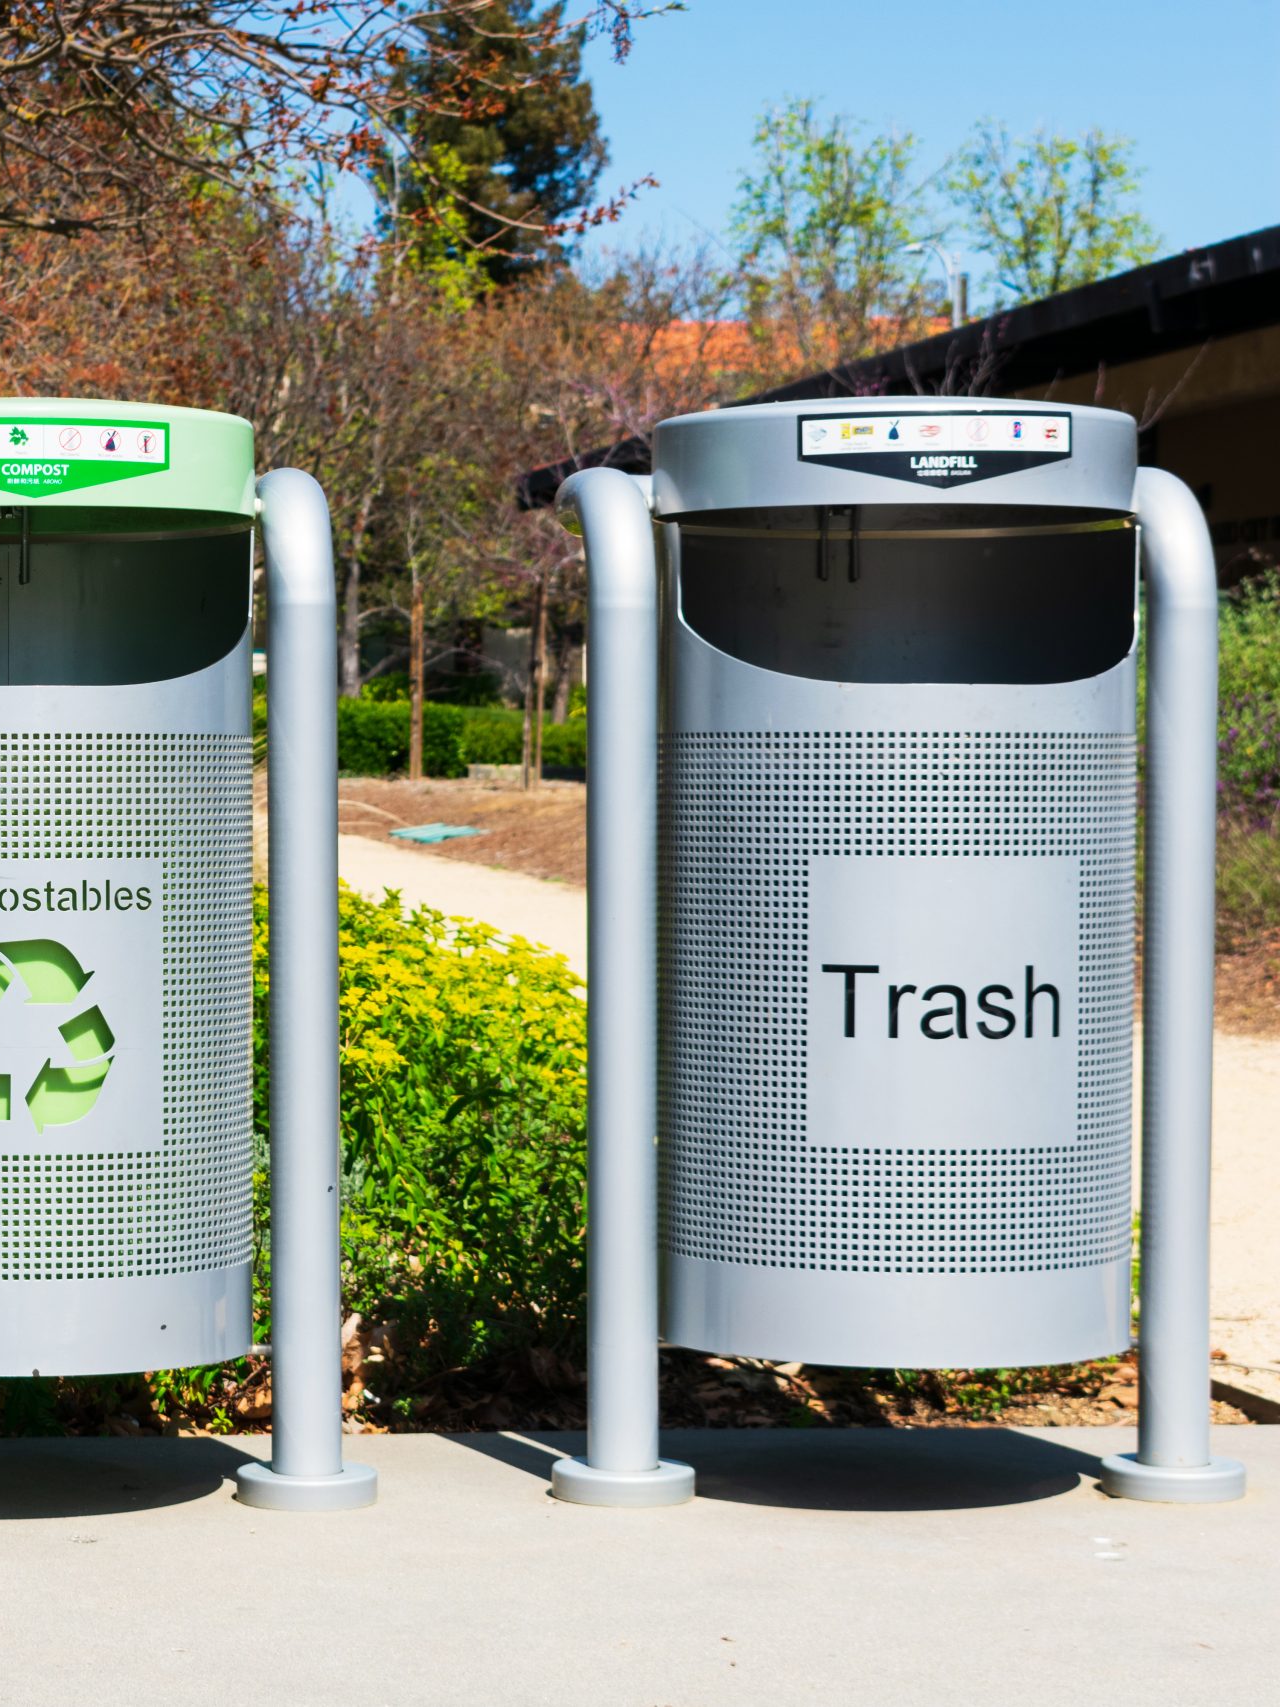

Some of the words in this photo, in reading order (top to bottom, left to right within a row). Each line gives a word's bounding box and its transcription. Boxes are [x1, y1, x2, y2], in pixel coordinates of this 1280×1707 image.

[910, 455, 979, 469] LANDFILL
[1, 463, 70, 476] COMPOST
[821, 963, 1060, 1040] Trash
